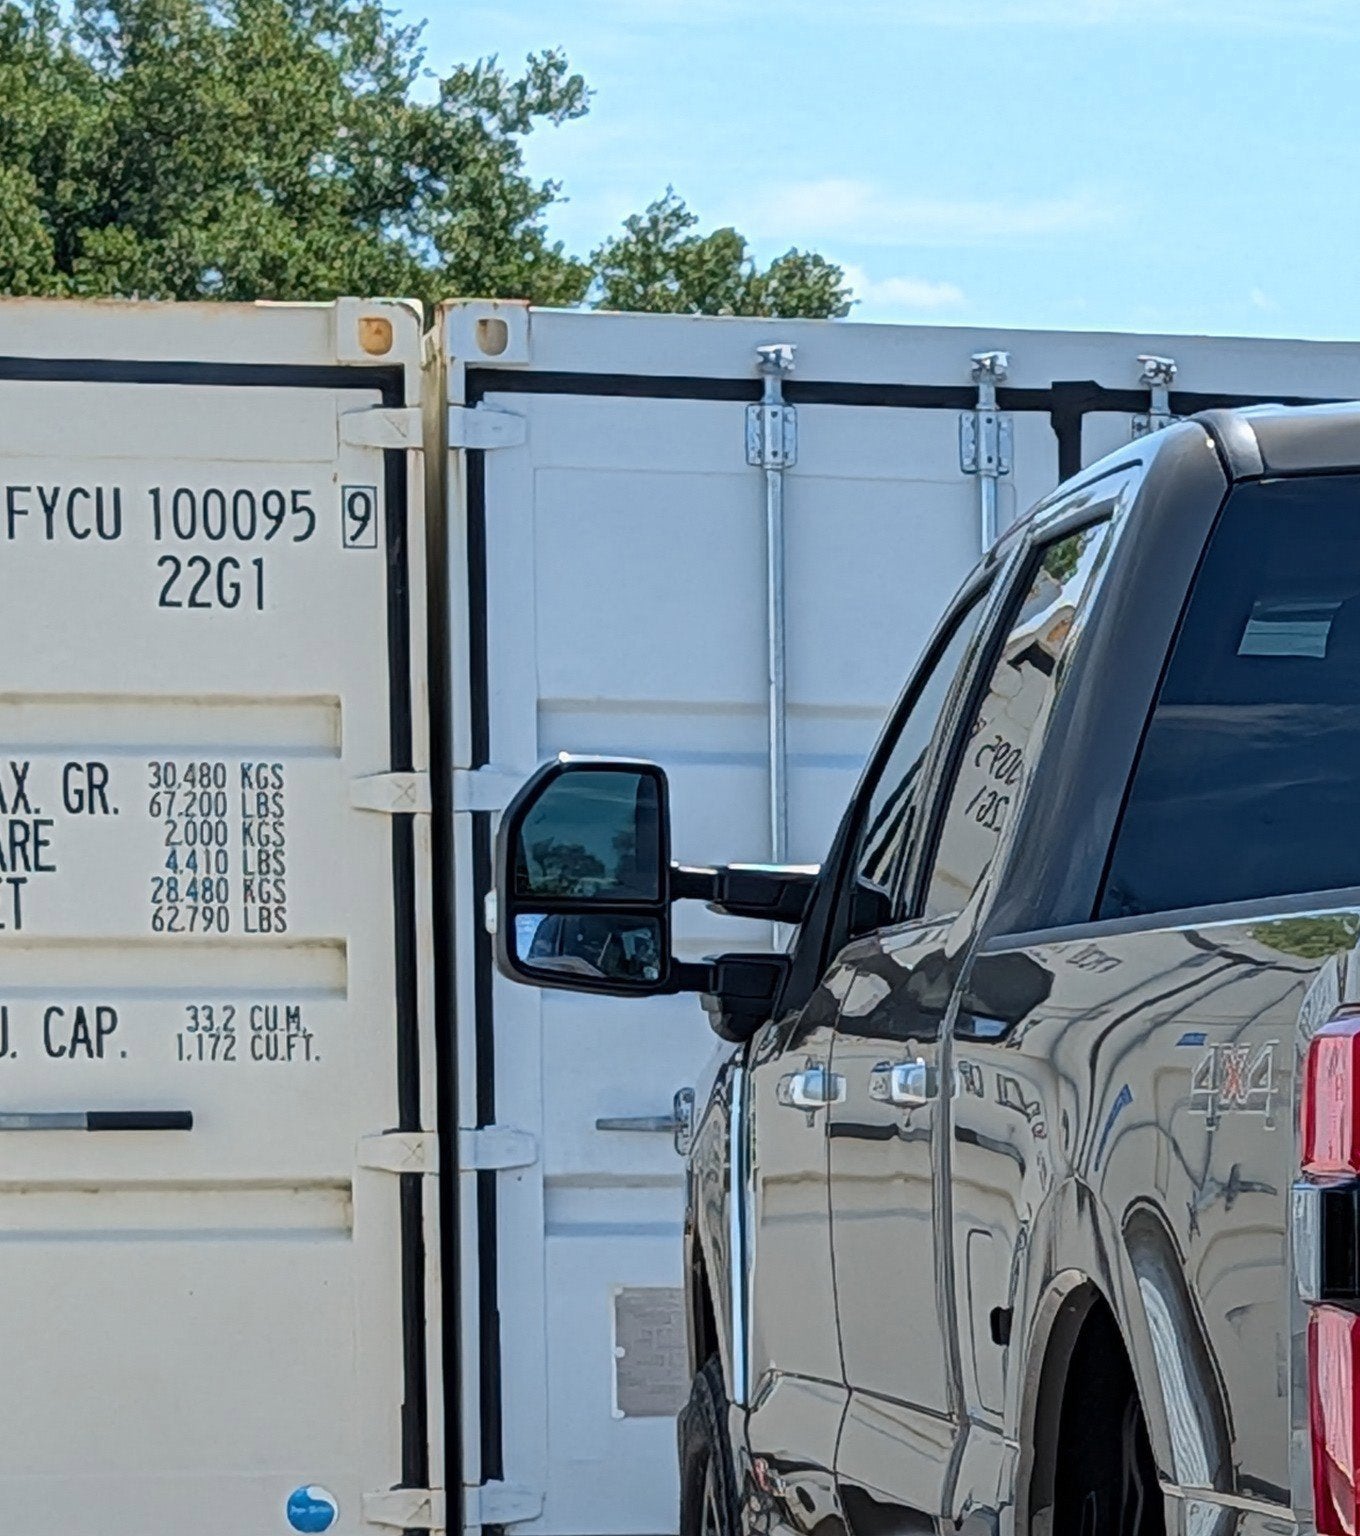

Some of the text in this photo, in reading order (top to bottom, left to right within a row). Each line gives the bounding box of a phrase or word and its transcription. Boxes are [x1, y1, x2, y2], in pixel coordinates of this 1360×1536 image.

[6, 485, 373, 543] FYCU 100095 9
[157, 554, 265, 611] 22G1
[62, 761, 119, 815] GR.
[240, 762, 284, 790] KGS
[241, 791, 285, 819] LBS
[242, 819, 286, 848] KGS
[242, 848, 286, 876] LBS
[243, 876, 287, 904] KGS
[243, 905, 288, 934] LBS
[43, 1004, 128, 1059] CAP.
